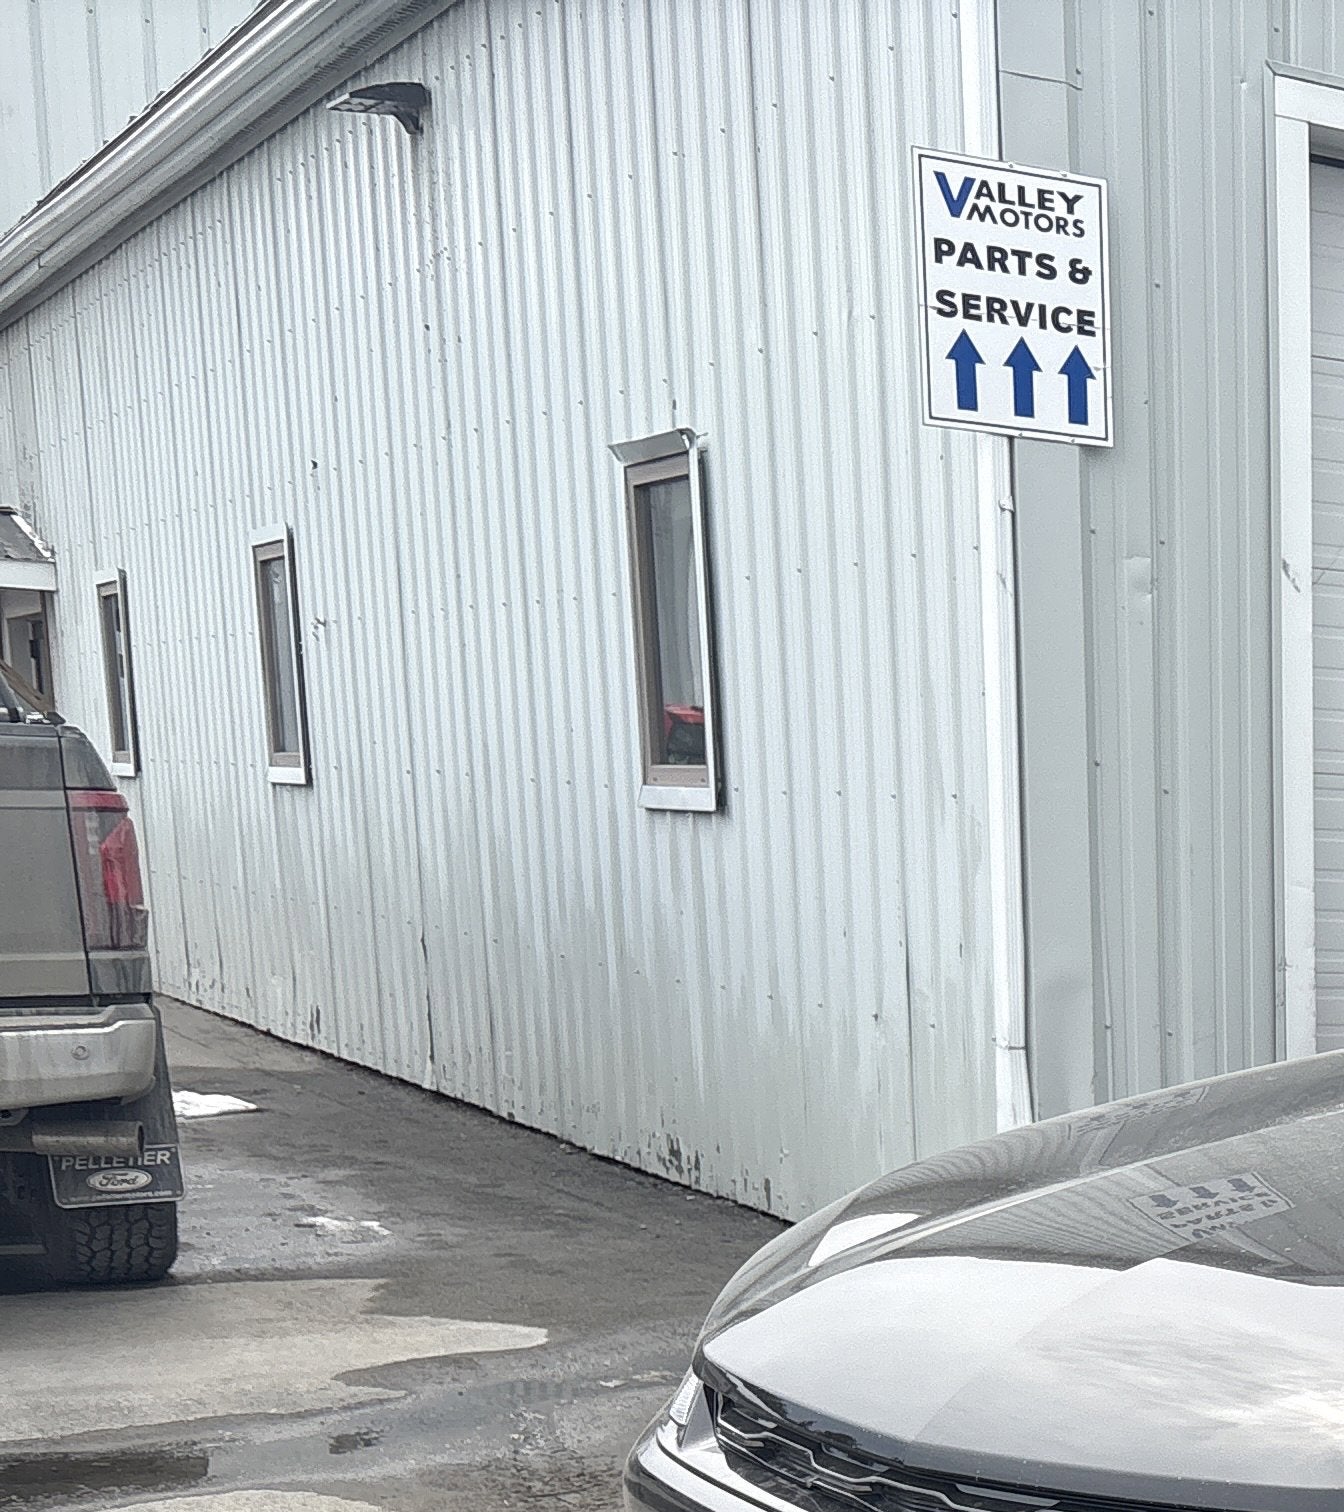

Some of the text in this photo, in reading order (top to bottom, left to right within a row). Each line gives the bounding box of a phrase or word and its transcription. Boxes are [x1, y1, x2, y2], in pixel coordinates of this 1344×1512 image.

[932, 170, 1084, 218] VALLEY
[966, 202, 1086, 239] MOTORS
[933, 237, 1093, 285] PARTS &
[934, 289, 1097, 338] SERVICE
[99, 1172, 139, 1187] Ford
